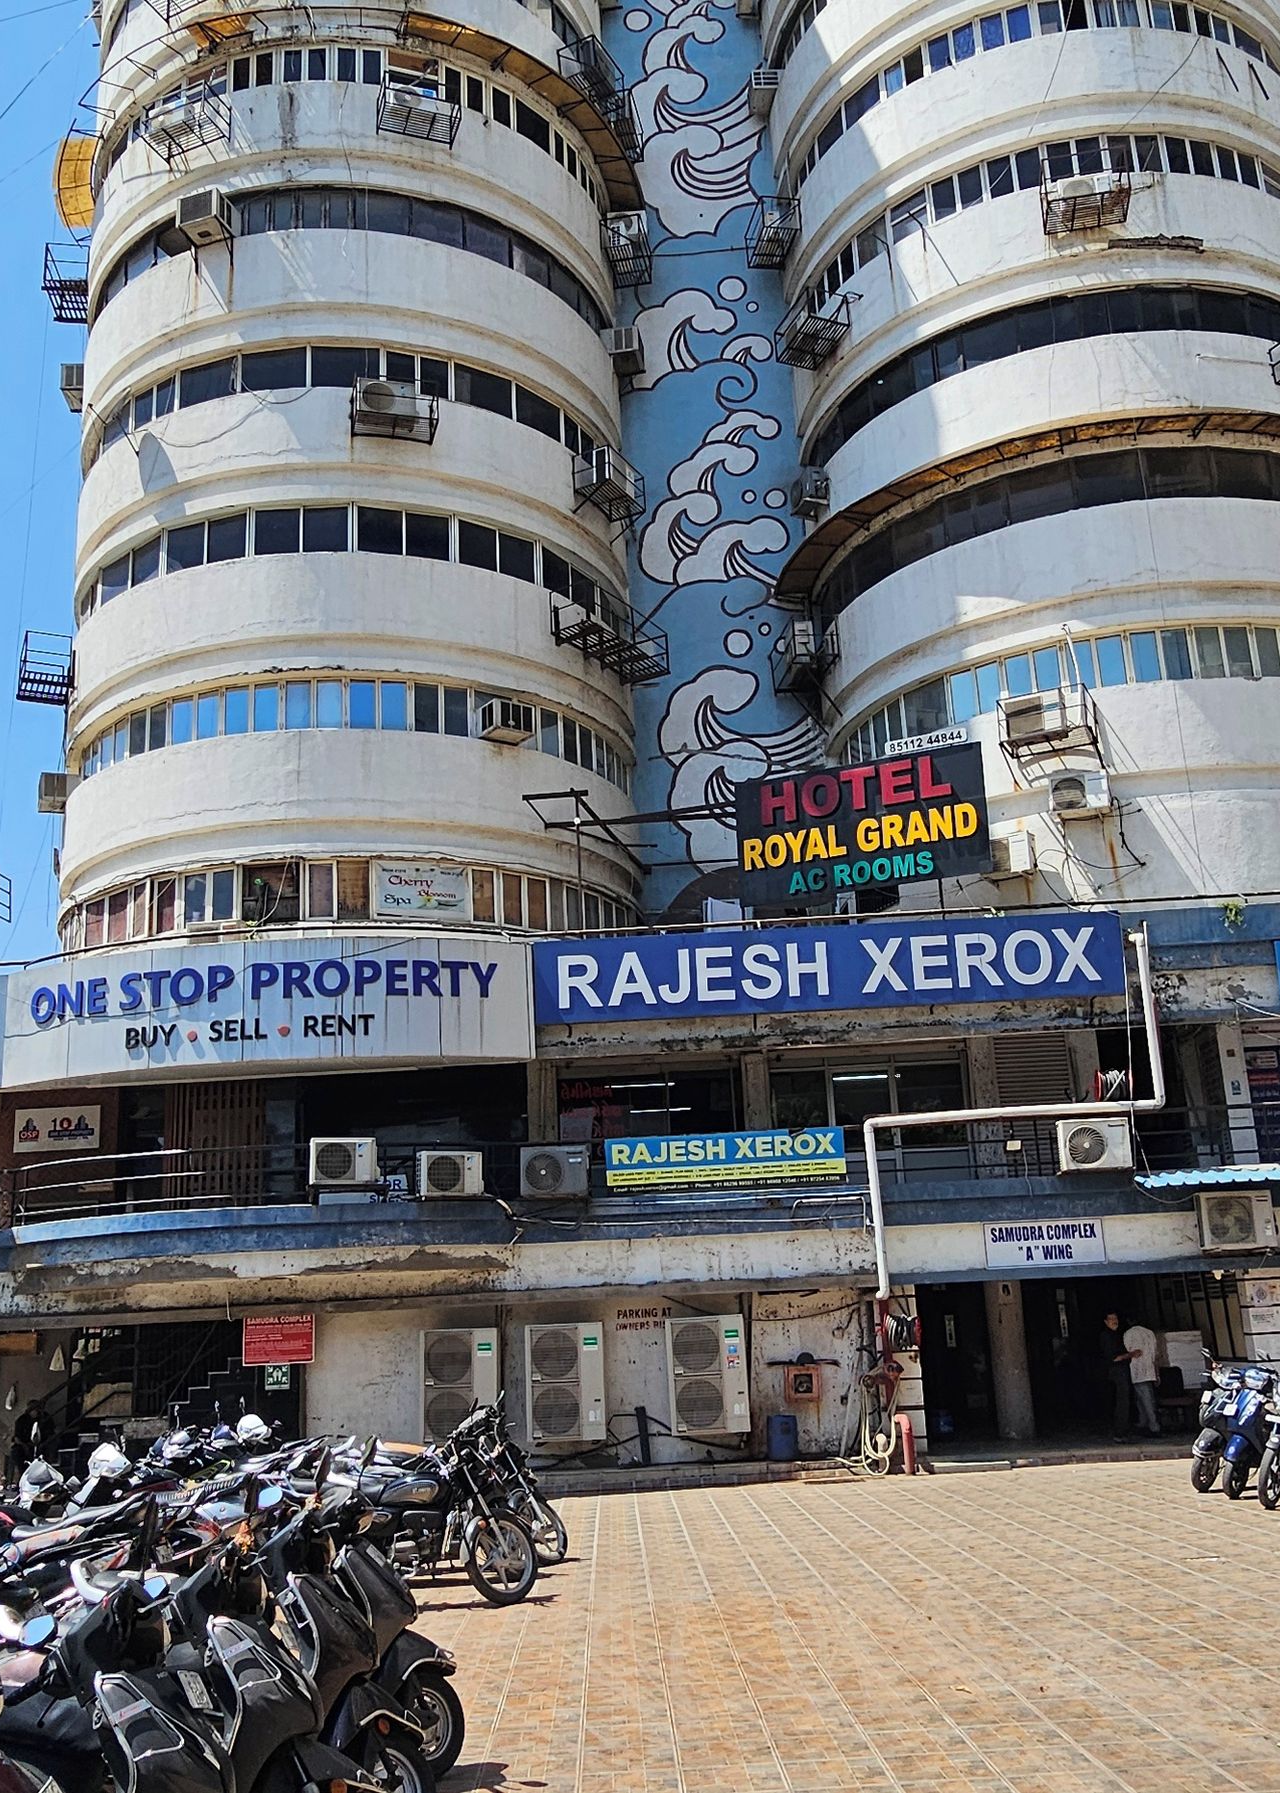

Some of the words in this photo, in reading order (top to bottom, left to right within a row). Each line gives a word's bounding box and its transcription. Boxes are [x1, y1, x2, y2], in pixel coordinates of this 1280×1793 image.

[889, 737, 923, 753] 85112
[926, 731, 963, 746] 44844
[760, 755, 953, 825] HOTEL
[743, 825, 847, 871] ROYAL
[857, 802, 978, 853] GRAND
[388, 874, 434, 889] Cherry
[789, 868, 826, 895] AC
[834, 851, 934, 888] ROOMS
[383, 893, 412, 906] Spa
[557, 941, 830, 1010] RAJESH
[860, 926, 1102, 994] XEROX
[30, 977, 108, 1024] ONE
[119, 964, 235, 1011] STOP
[251, 959, 498, 1000] PROPERTY
[125, 1023, 177, 1050] BUY
[208, 1017, 268, 1042] SELL
[303, 1014, 375, 1038] RENT
[611, 1139, 725, 1165] RAJESH
[735, 1133, 836, 1158] XEROX
[991, 1226, 1045, 1243] SAMUDRA
[1047, 1223, 1097, 1240] COMPLEX
[1042, 1244, 1073, 1260] WING
[616, 1319, 650, 1331] OWNERS
[617, 1307, 657, 1320] PARKING
[658, 1307, 672, 1319] AT
